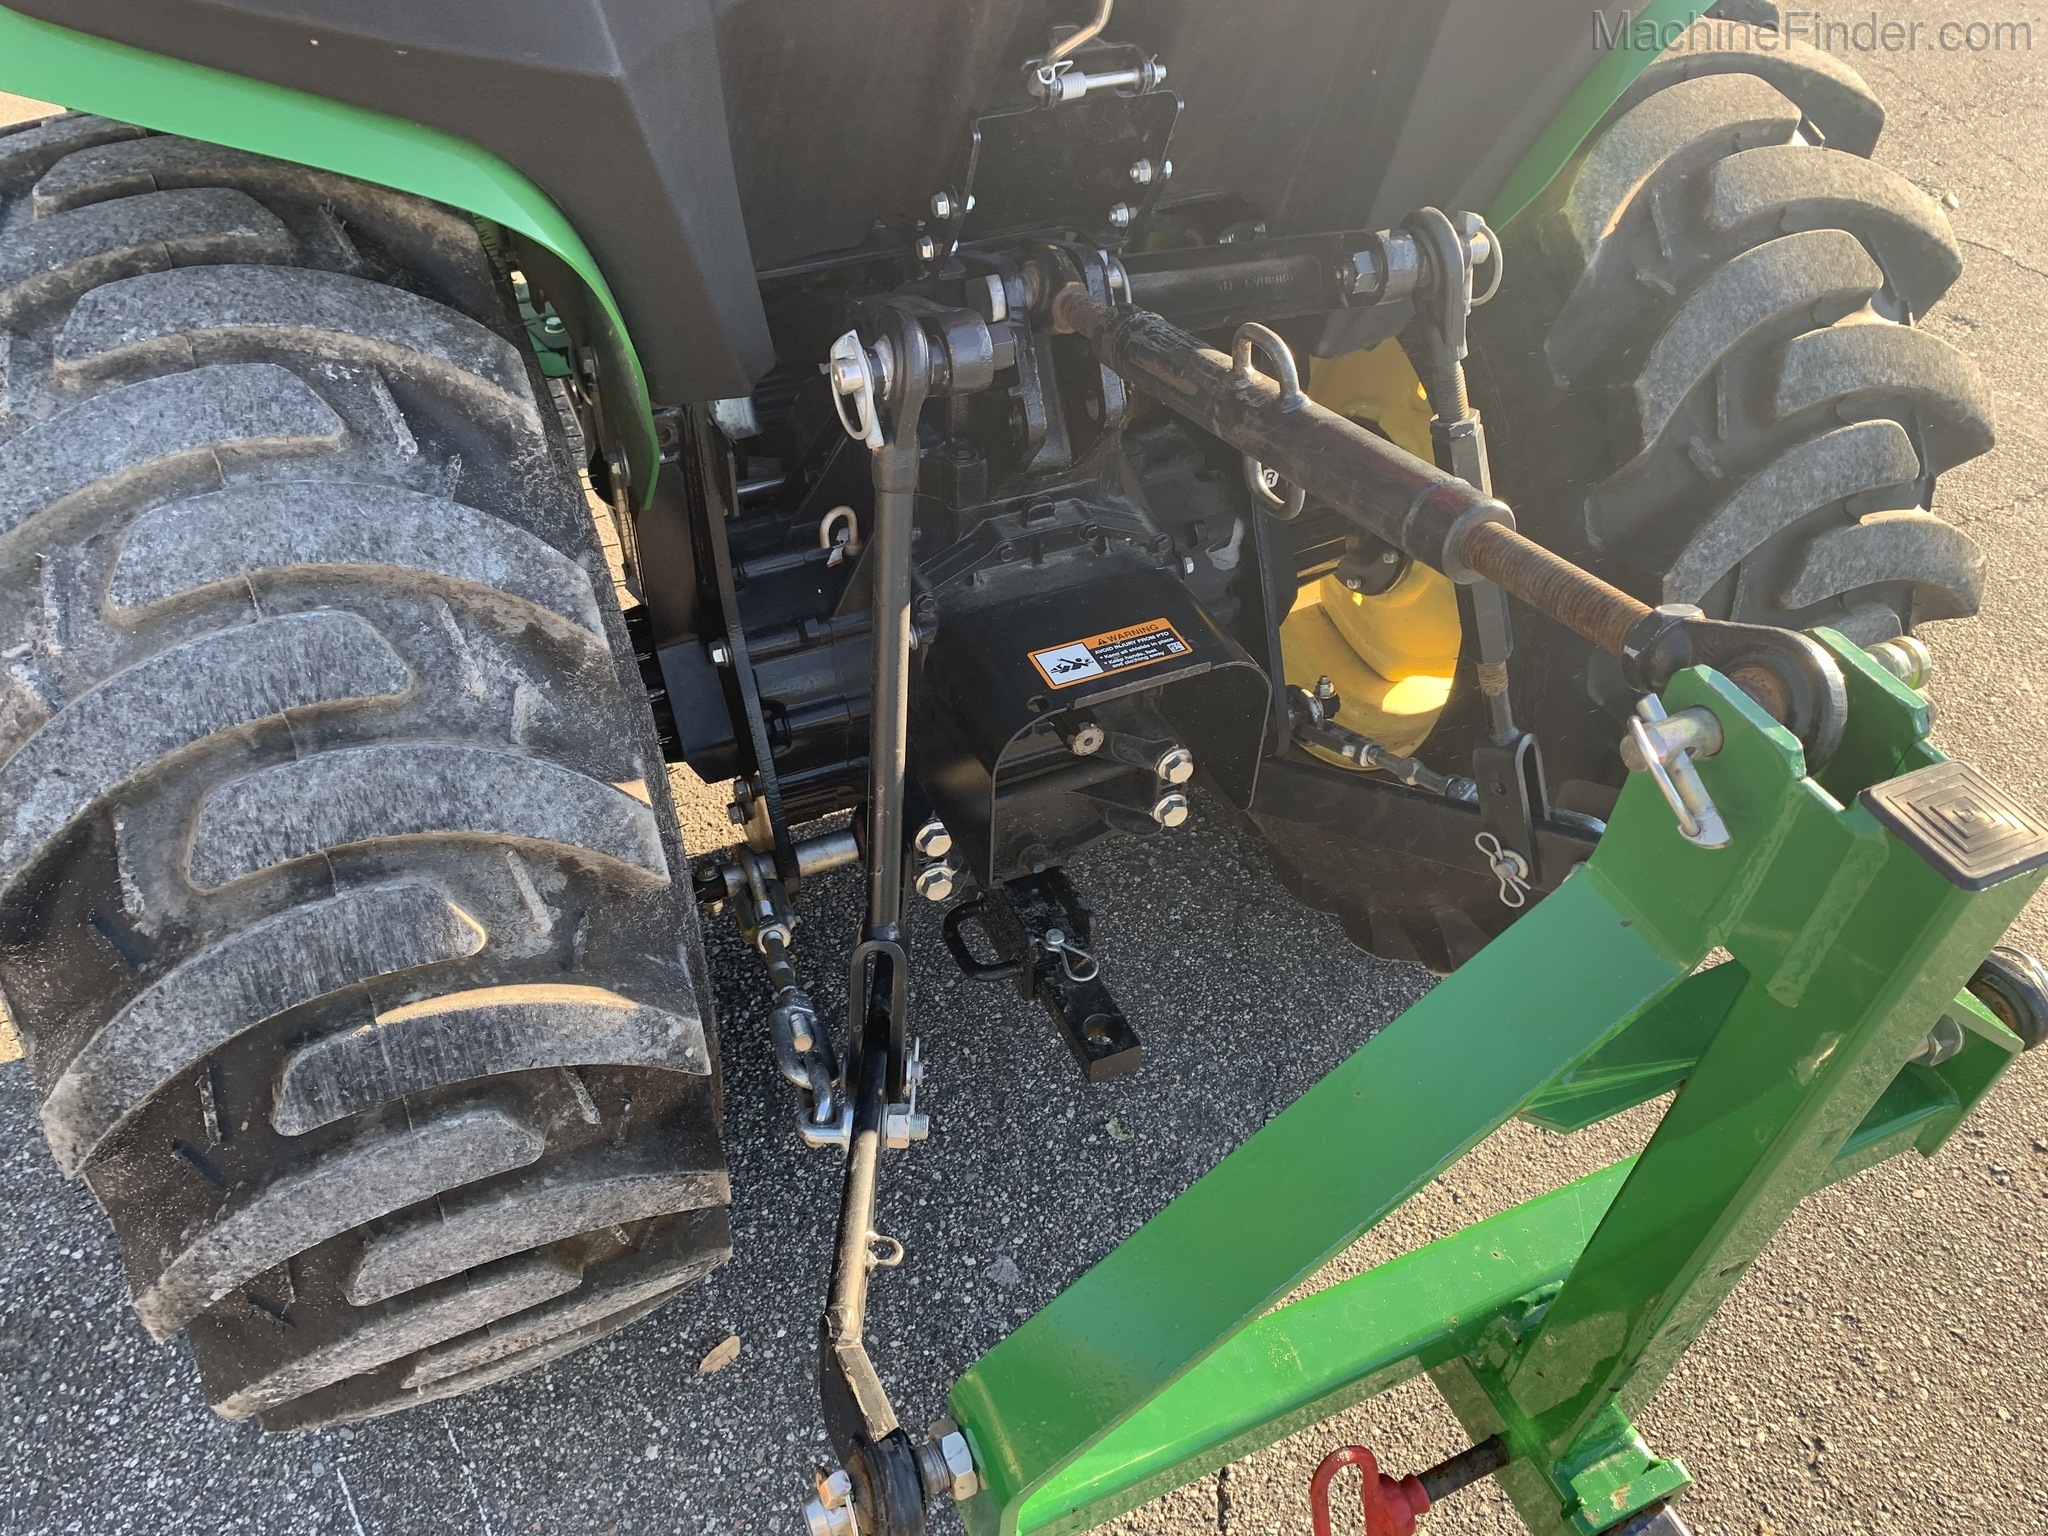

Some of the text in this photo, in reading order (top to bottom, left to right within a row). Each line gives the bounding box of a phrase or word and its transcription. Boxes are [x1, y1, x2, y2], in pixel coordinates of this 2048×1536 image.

[1107, 624, 1159, 642] WARNING
[1095, 646, 1114, 655] AVOID
[1114, 640, 1136, 650] INJURY
[1137, 635, 1156, 643] FROM
[1129, 643, 1150, 652] shields
[1158, 637, 1174, 645] place
[1108, 657, 1124, 665] Keep
[1124, 656, 1149, 665] clothing
